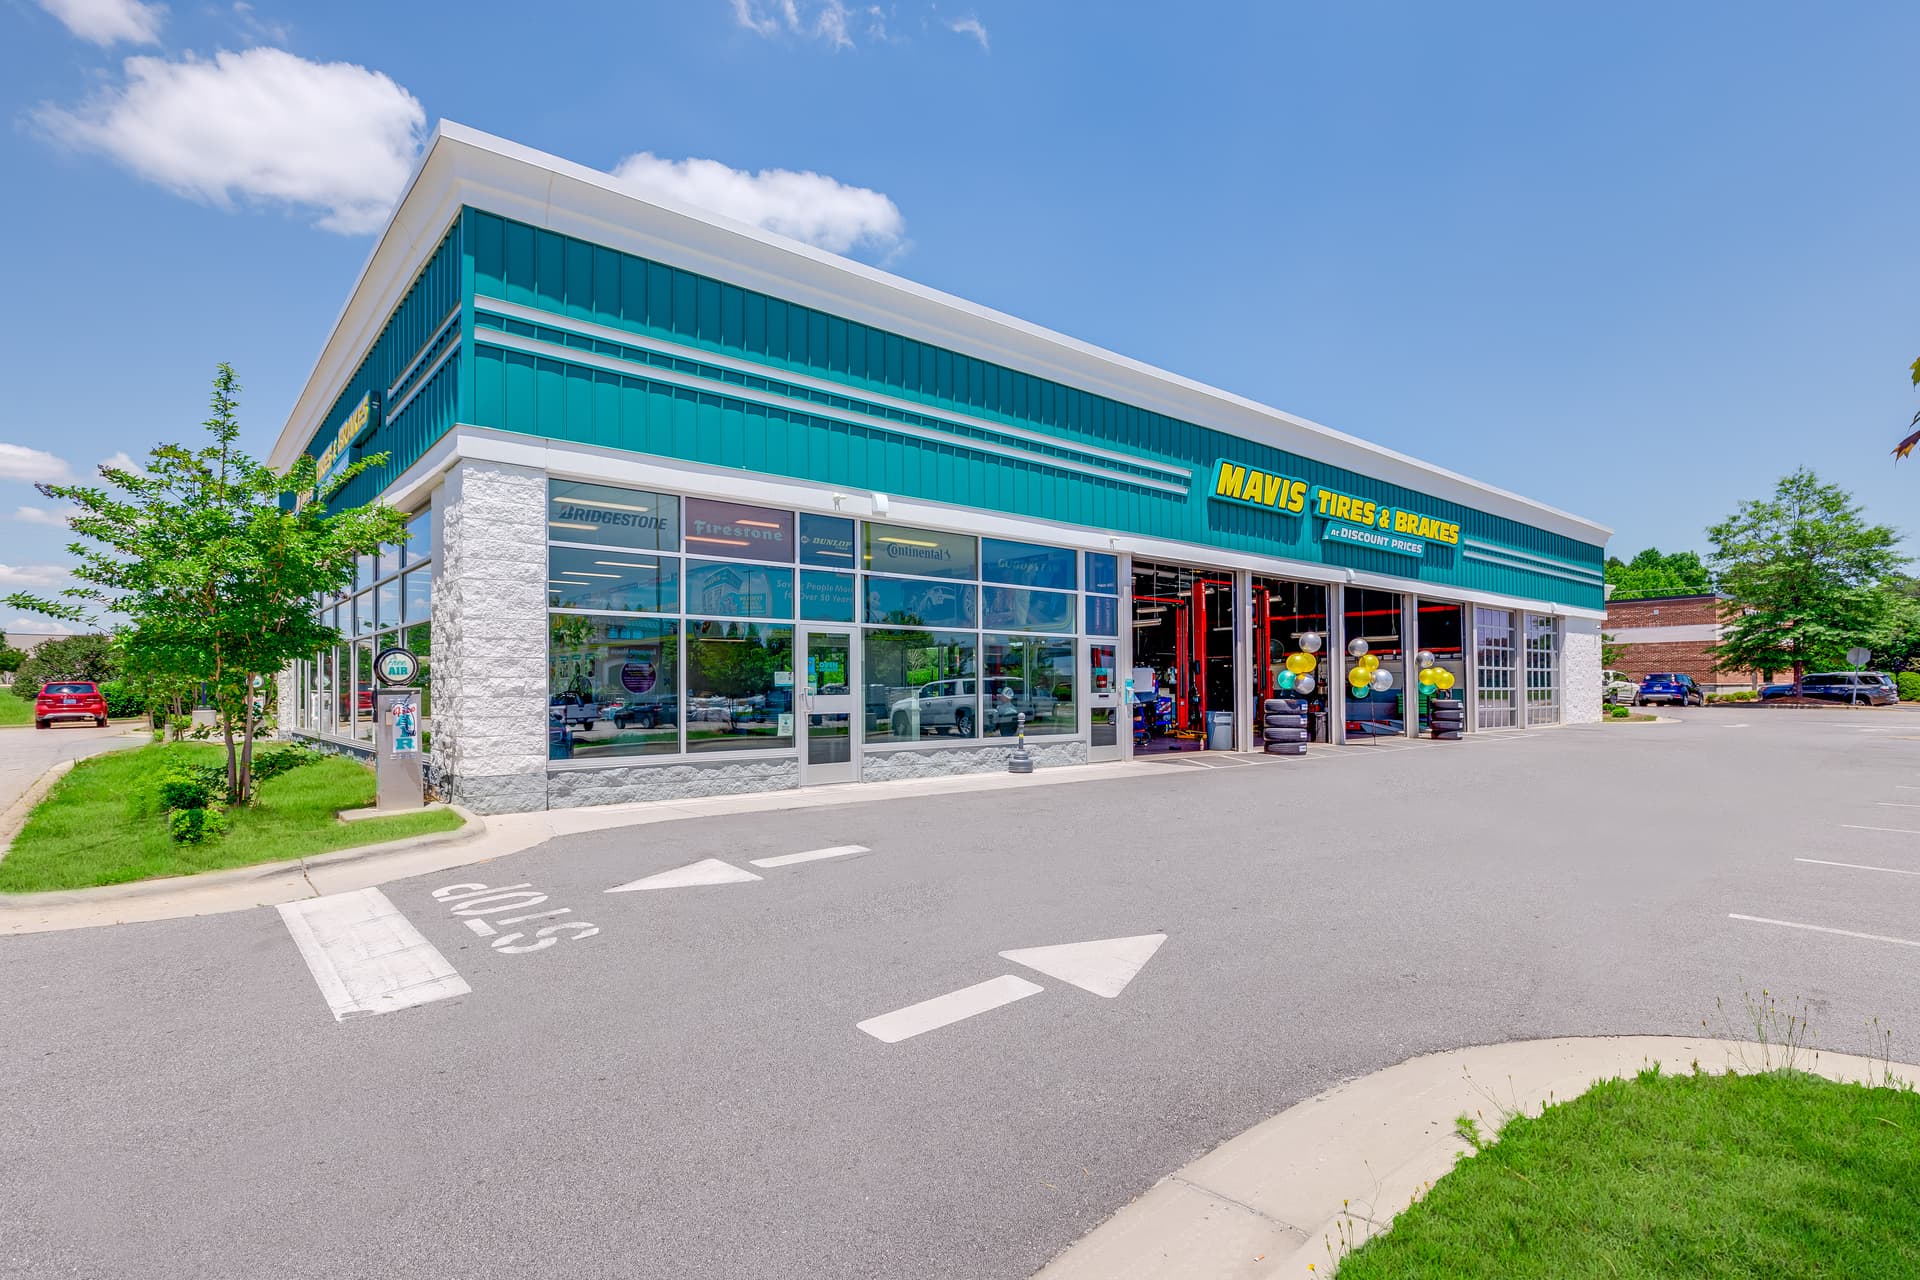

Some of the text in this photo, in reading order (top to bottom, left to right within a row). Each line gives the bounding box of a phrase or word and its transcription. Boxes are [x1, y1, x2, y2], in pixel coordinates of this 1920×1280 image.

[1215, 462, 1460, 545] MAVIS TIRES & BRAKES
[558, 504, 668, 531] BRIDGESTONE
[693, 518, 784, 542] Firestone
[886, 541, 943, 560] Continental
[1340, 528, 1389, 547] DISCOUNT
[1391, 539, 1423, 554] PRICES
[806, 582, 834, 592] People
[388, 666, 408, 675] AIR
[432, 882, 600, 953] STOP
